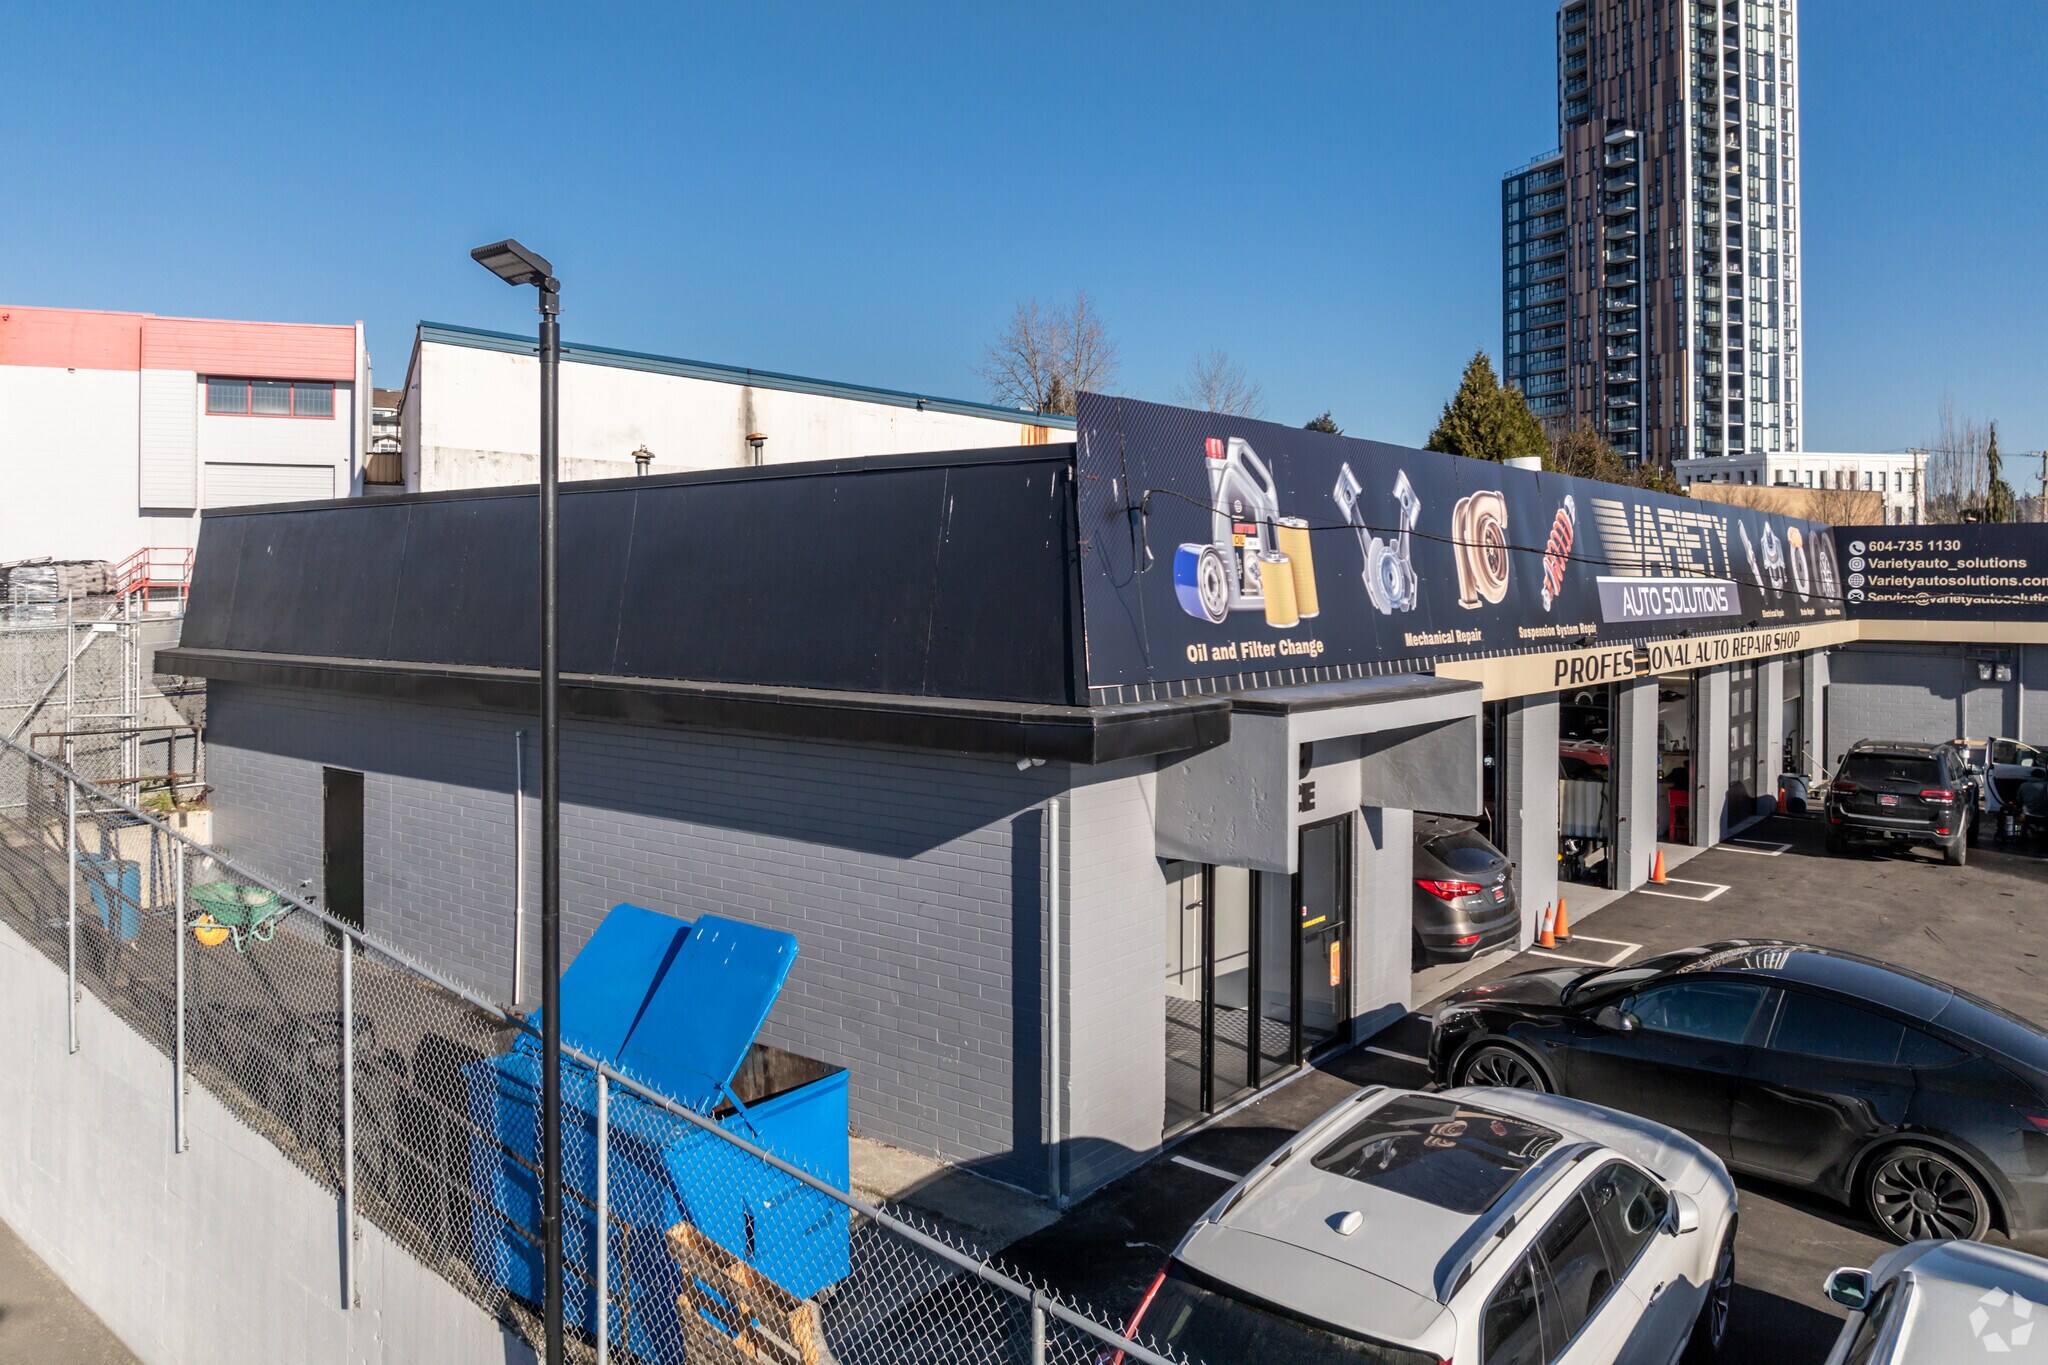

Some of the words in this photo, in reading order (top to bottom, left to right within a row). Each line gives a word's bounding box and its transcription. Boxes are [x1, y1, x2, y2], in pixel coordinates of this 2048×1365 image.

[1869, 540, 1923, 552] 604-735
[1927, 540, 1961, 551] 1130
[1868, 557, 2027, 571] Varietyauto_solutions
[1623, 587, 1662, 616] AUTO
[1662, 587, 1729, 614] SOLUTIONS
[1404, 629, 1455, 647] Mechanical
[1455, 628, 1482, 645] Repair
[1519, 624, 1555, 640] Suspension
[1556, 624, 1579, 639] System
[1579, 622, 1597, 636] Repair
[1186, 643, 1208, 662] Oil
[1211, 642, 1238, 661] and
[1240, 640, 1276, 659] Filter
[1279, 639, 1325, 658] Change
[1694, 638, 1729, 664] AUTO
[1732, 634, 1772, 657] REPAIR
[1773, 630, 1801, 651] SHOP
